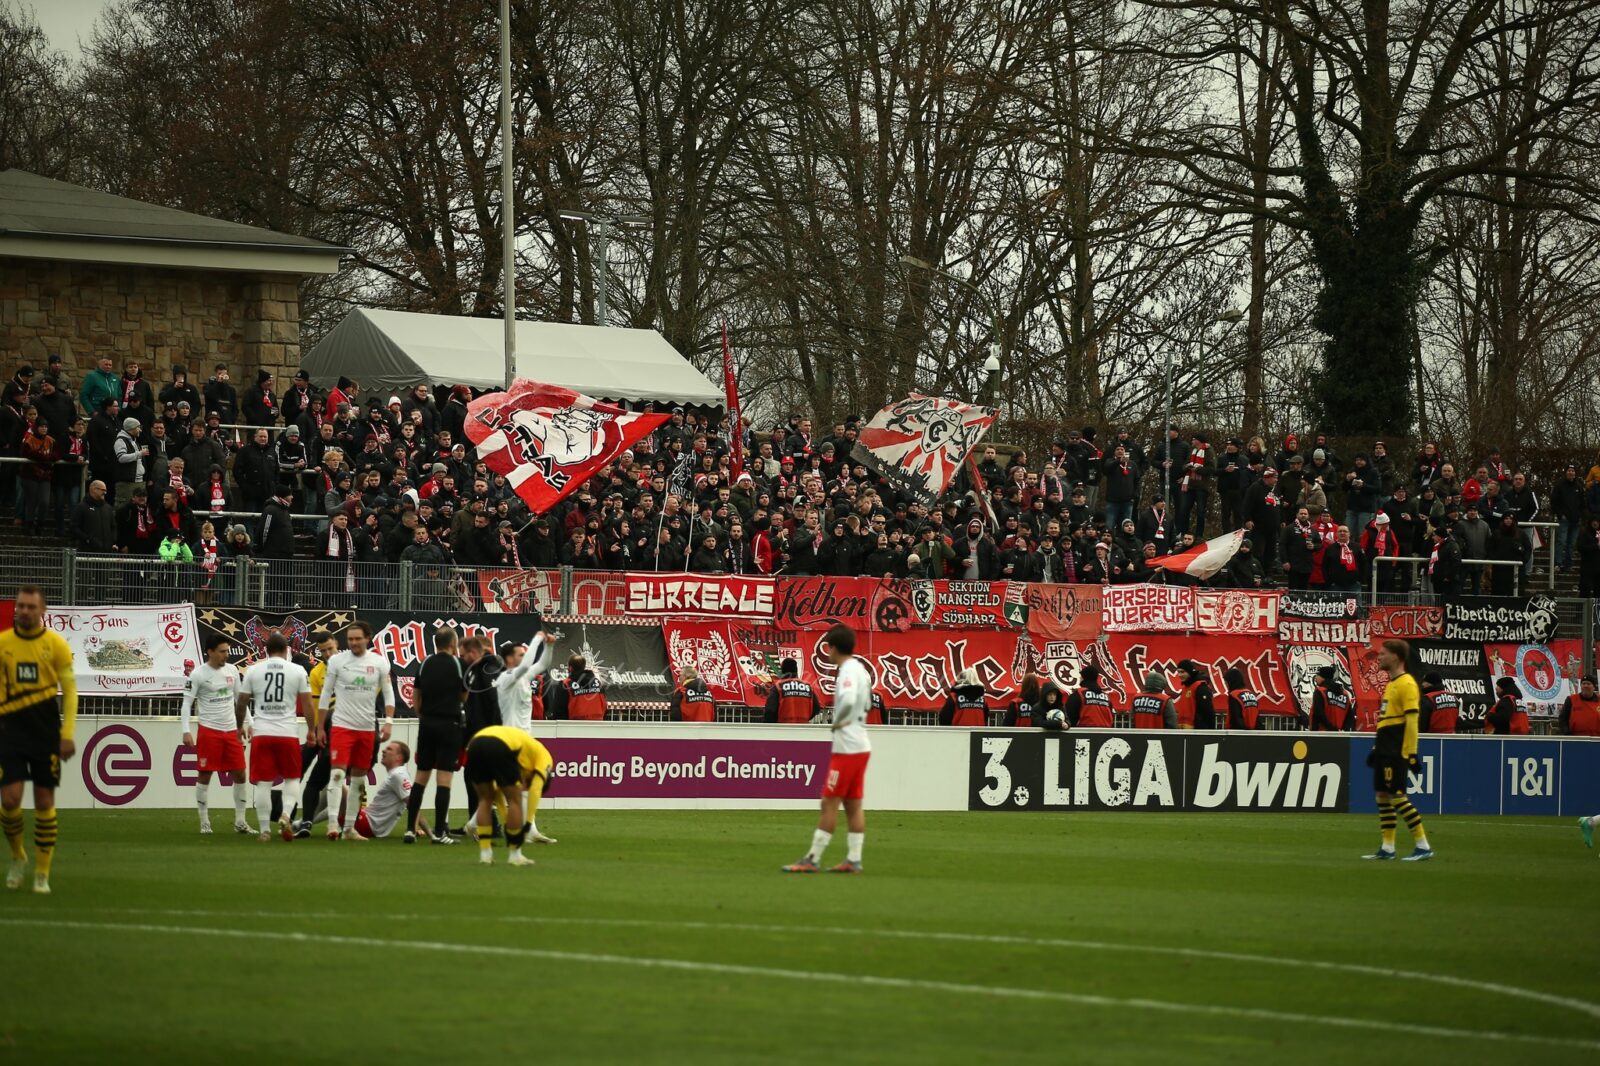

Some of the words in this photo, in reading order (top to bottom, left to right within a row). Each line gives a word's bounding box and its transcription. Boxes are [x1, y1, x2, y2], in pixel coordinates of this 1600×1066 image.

[948, 582, 990, 592] SEKTION
[629, 581, 774, 613] SURREALE
[778, 577, 867, 627] Köthen
[938, 593, 1001, 606] MANSFELD
[1103, 588, 1190, 607] MERSEBUR
[91, 614, 129, 632] Fans
[163, 613, 183, 622] HFC
[942, 610, 997, 624] SÜDHARZ
[1389, 610, 1427, 635] CTK
[1279, 621, 1369, 643] STENDAL
[1050, 644, 1073, 656] HFC
[1419, 648, 1480, 666] DOMFALKEN
[95, 674, 156, 689] Rosengarten
[264, 672, 285, 703] 28
[782, 680, 810, 691] atlas
[1442, 679, 1486, 695] SEBURG
[1133, 698, 1160, 709] atlas
[551, 756, 625, 785] eading
[631, 756, 707, 785] Beyond
[711, 757, 816, 786] Chemistry
[978, 737, 1030, 807] 3.
[1043, 737, 1175, 808] LIGA
[1193, 740, 1342, 808] bwin
[1507, 757, 1554, 796] 1&1
